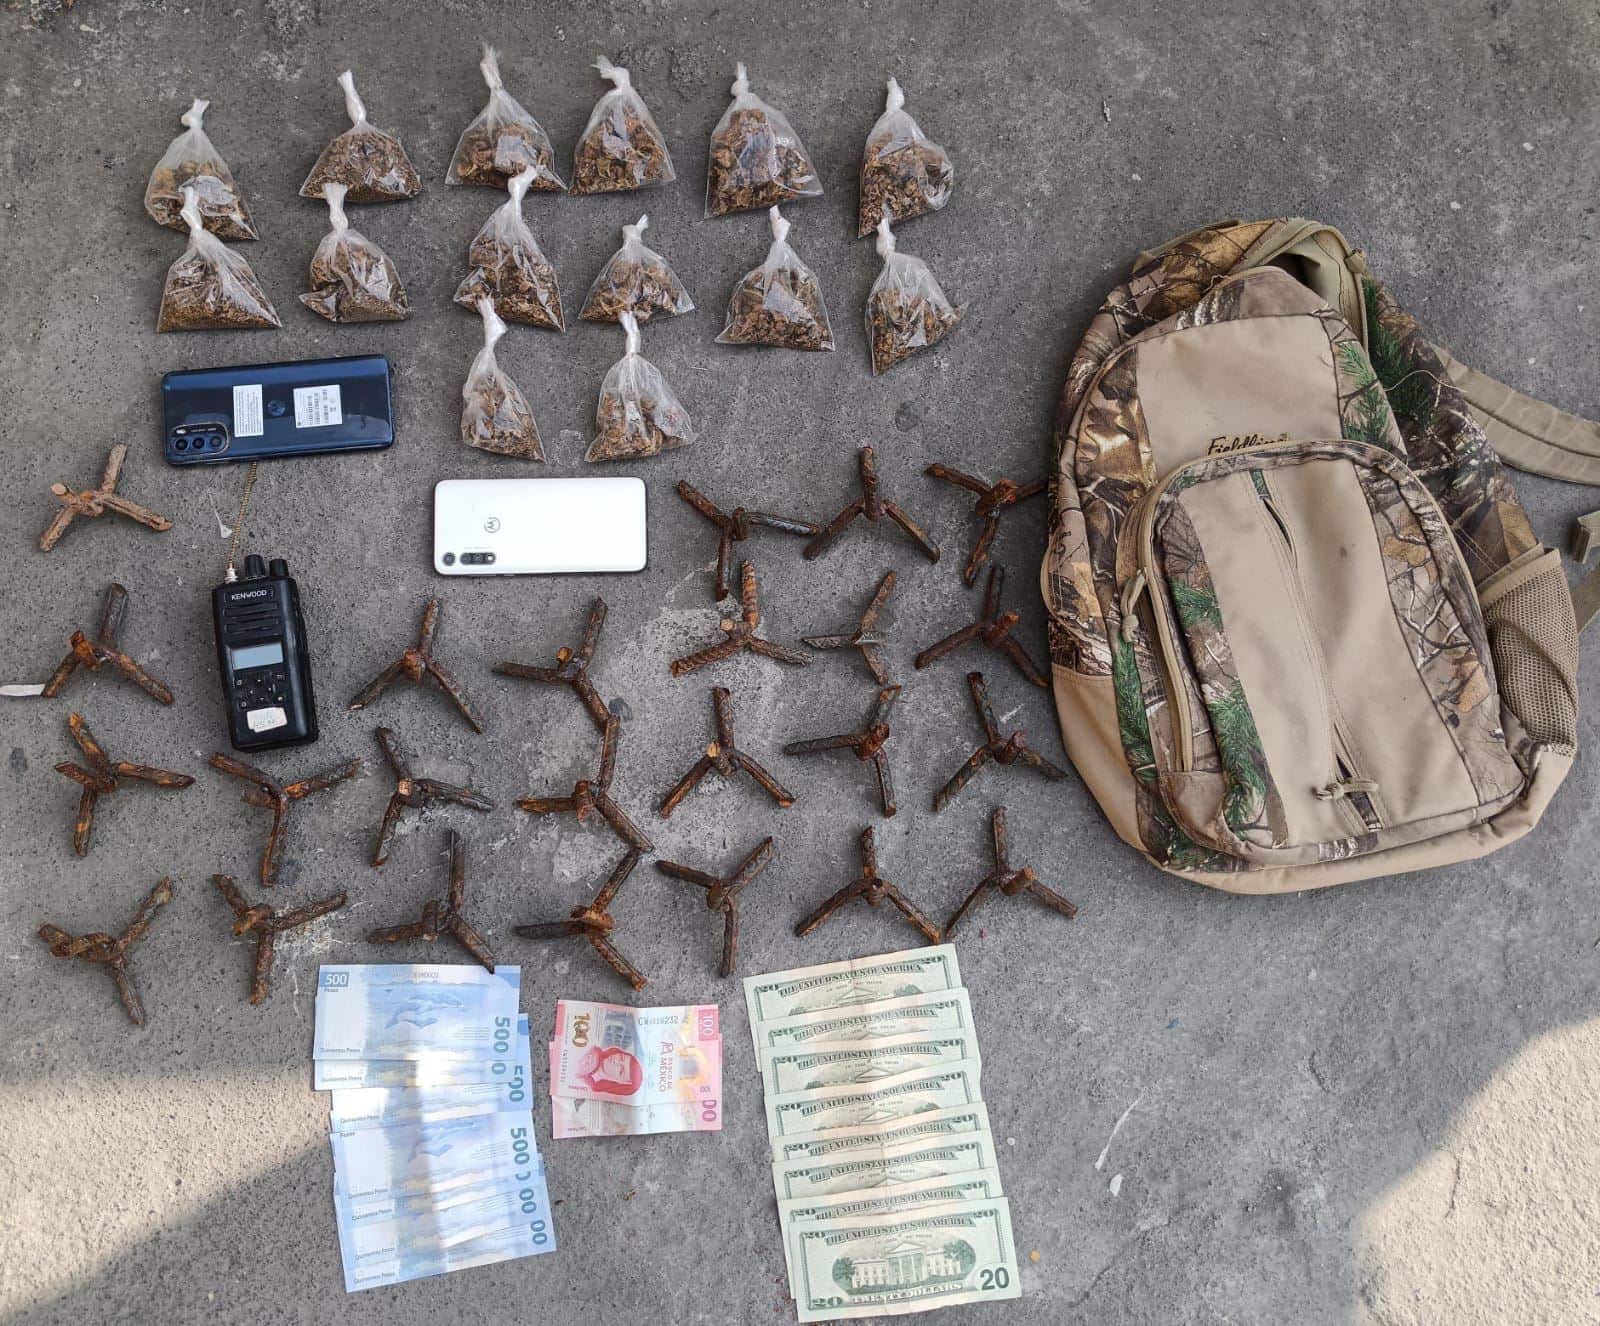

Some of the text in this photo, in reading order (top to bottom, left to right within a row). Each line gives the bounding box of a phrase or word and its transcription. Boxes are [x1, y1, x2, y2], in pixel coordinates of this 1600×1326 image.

[231, 589, 267, 601] KENWOOD
[325, 973, 347, 986] 500
[494, 1016, 511, 1054] 500
[571, 1013, 591, 1048] 100
[702, 1015, 714, 1036] 100
[511, 1127, 530, 1165] 500
[980, 1266, 1010, 1291] 20
[812, 1296, 843, 1308] 20
